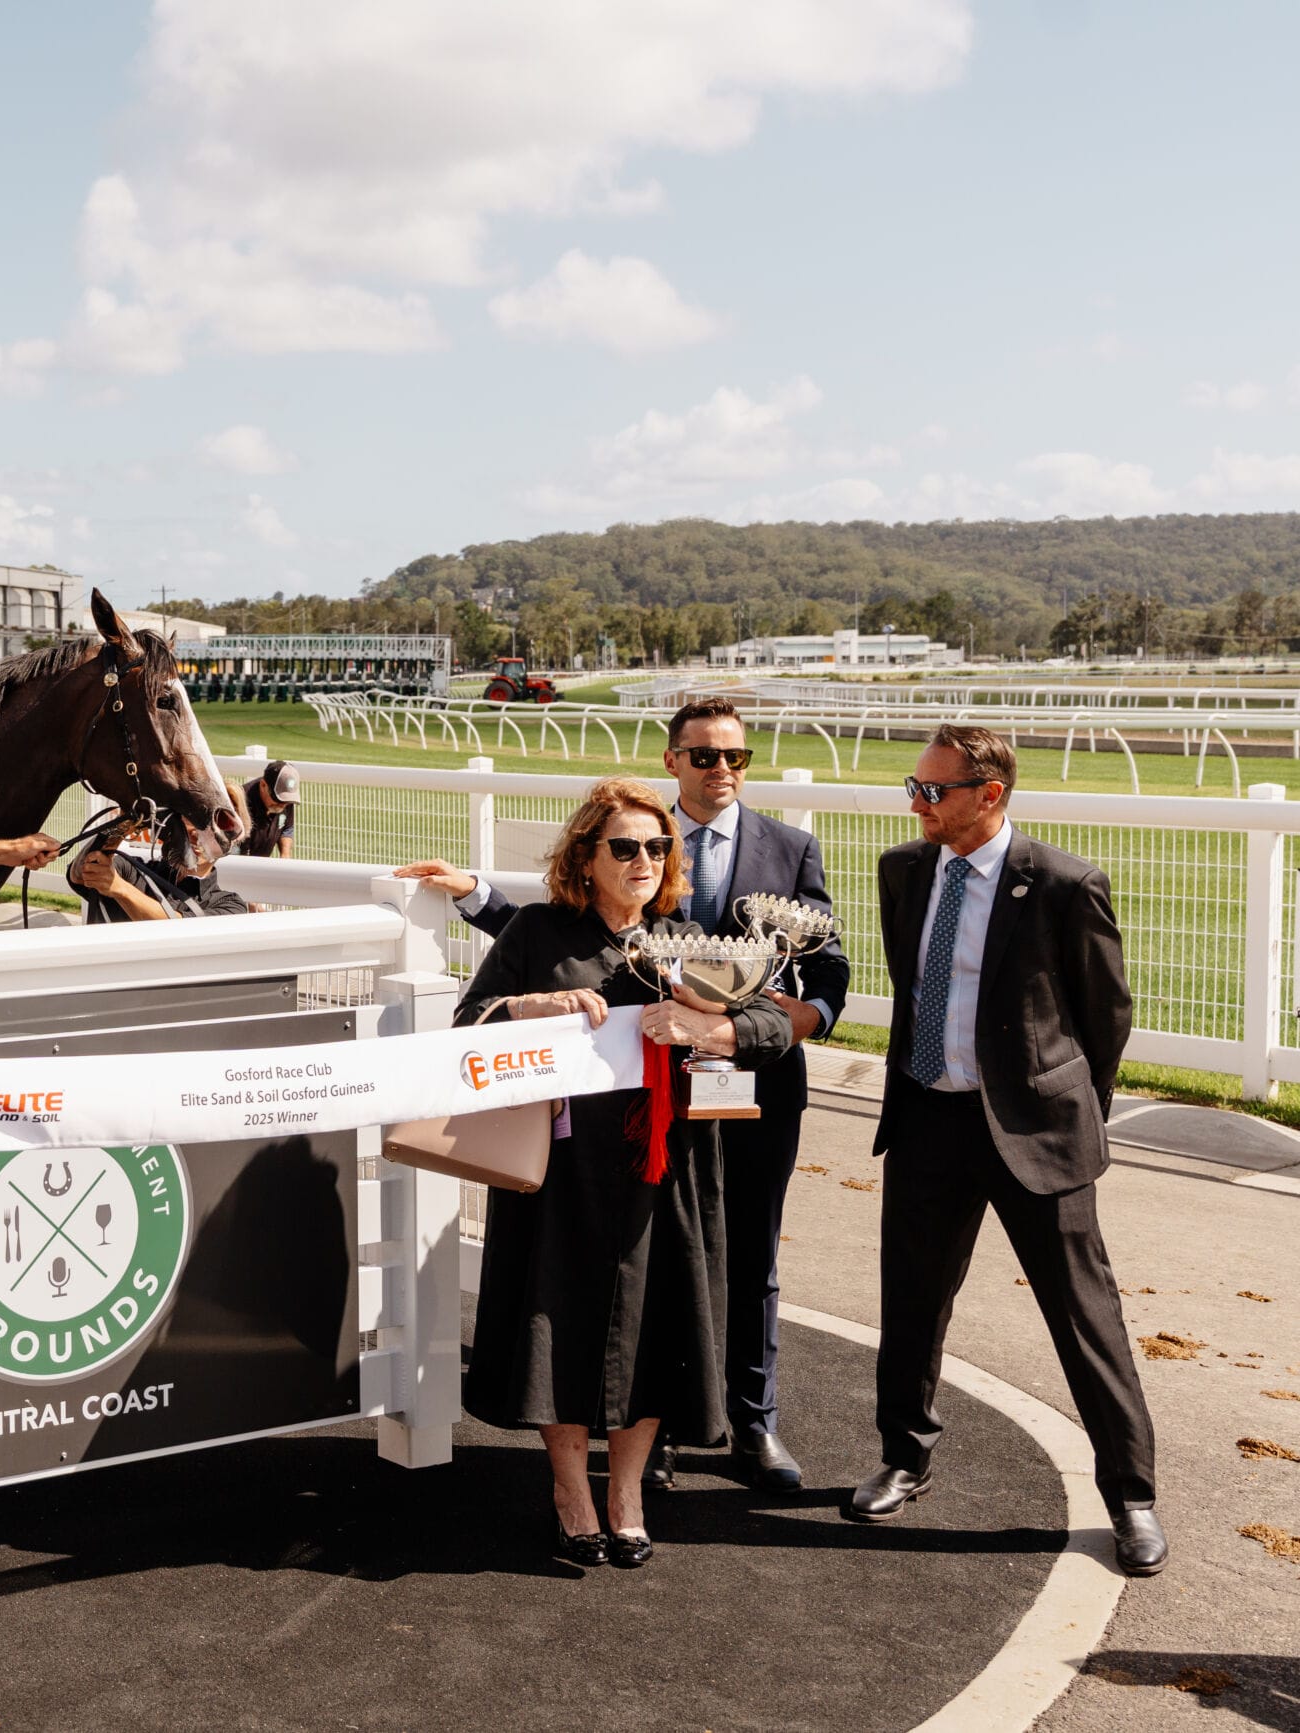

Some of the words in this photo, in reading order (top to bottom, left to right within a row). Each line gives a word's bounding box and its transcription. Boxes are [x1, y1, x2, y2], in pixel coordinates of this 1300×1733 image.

[493, 1048, 555, 1071] ELITE
[225, 1065, 273, 1082] Gosford
[276, 1066, 303, 1079] Race
[305, 1063, 332, 1077] Club
[495, 1070, 525, 1082] SAND
[534, 1066, 558, 1076] SOIL
[181, 1093, 208, 1107] Elite
[211, 1091, 241, 1105] Sand
[245, 1091, 254, 1103] &
[257, 1088, 279, 1103] Soil
[281, 1085, 327, 1101] Gosford
[330, 1082, 375, 1097] Guineas
[31, 1113, 61, 1123] SOIL
[244, 1112, 274, 1126] 2025
[277, 1110, 318, 1124] Winner
[81, 1383, 174, 1420] COAST
